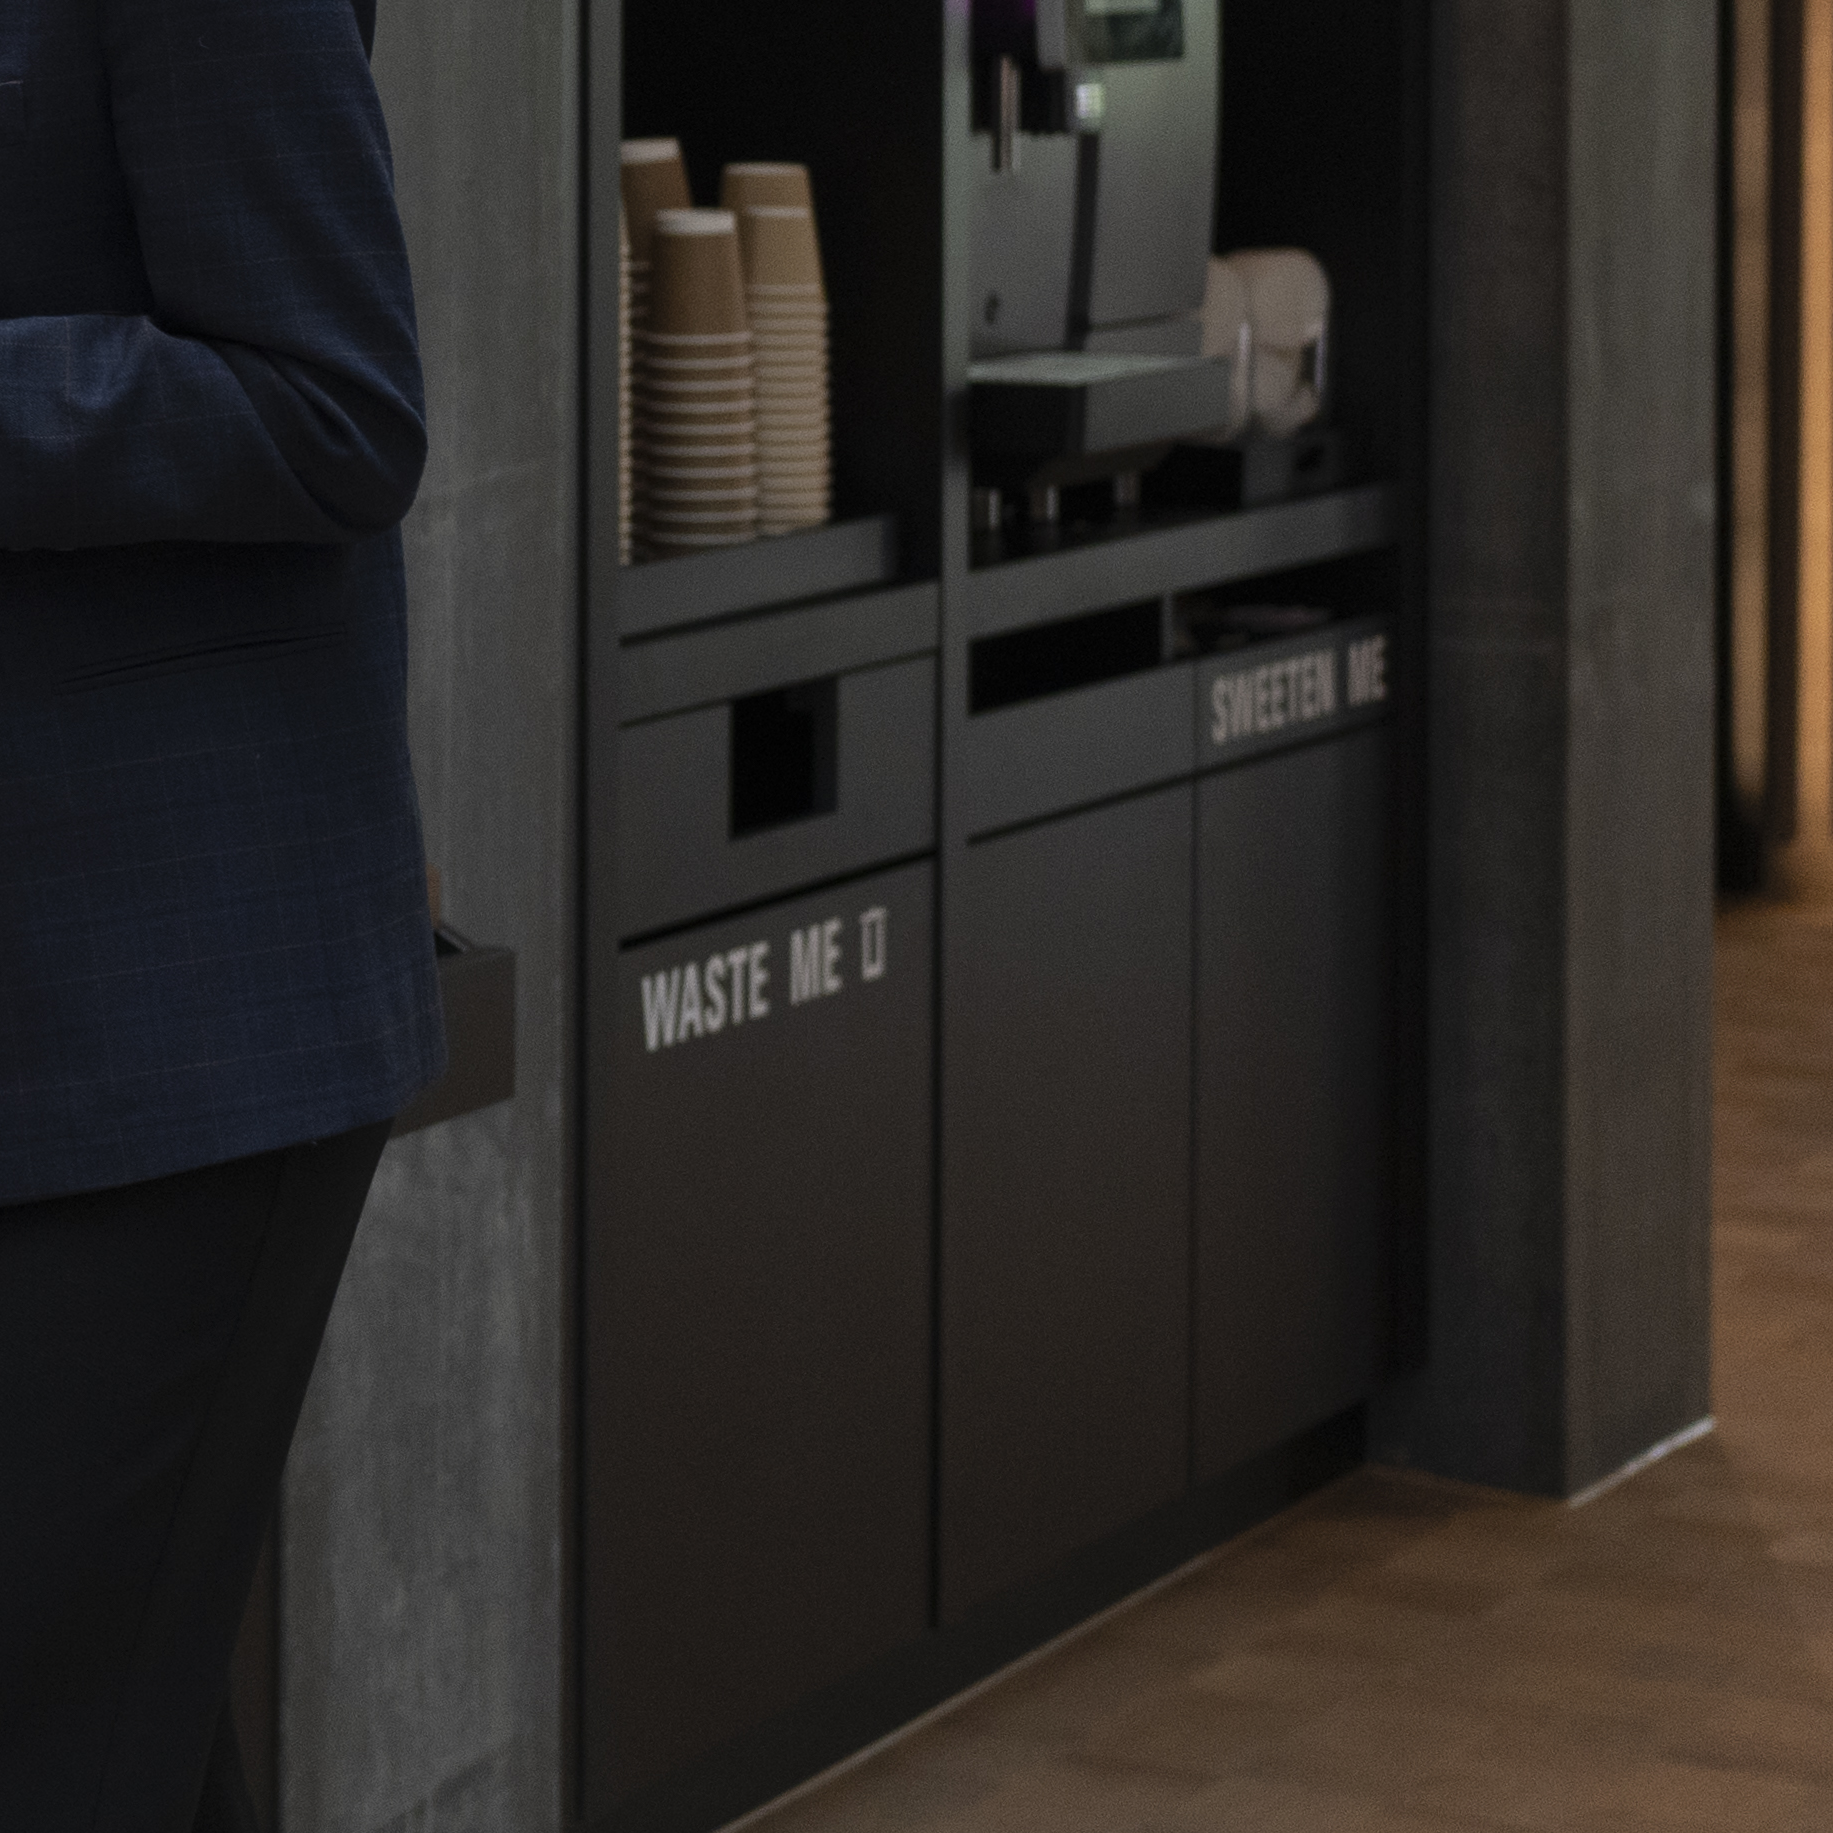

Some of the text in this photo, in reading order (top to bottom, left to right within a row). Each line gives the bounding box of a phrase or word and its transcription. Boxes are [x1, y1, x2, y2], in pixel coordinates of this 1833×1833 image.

[1212, 634, 1388, 745] SWEETEN ME
[641, 918, 843, 1051] WASTE ME
